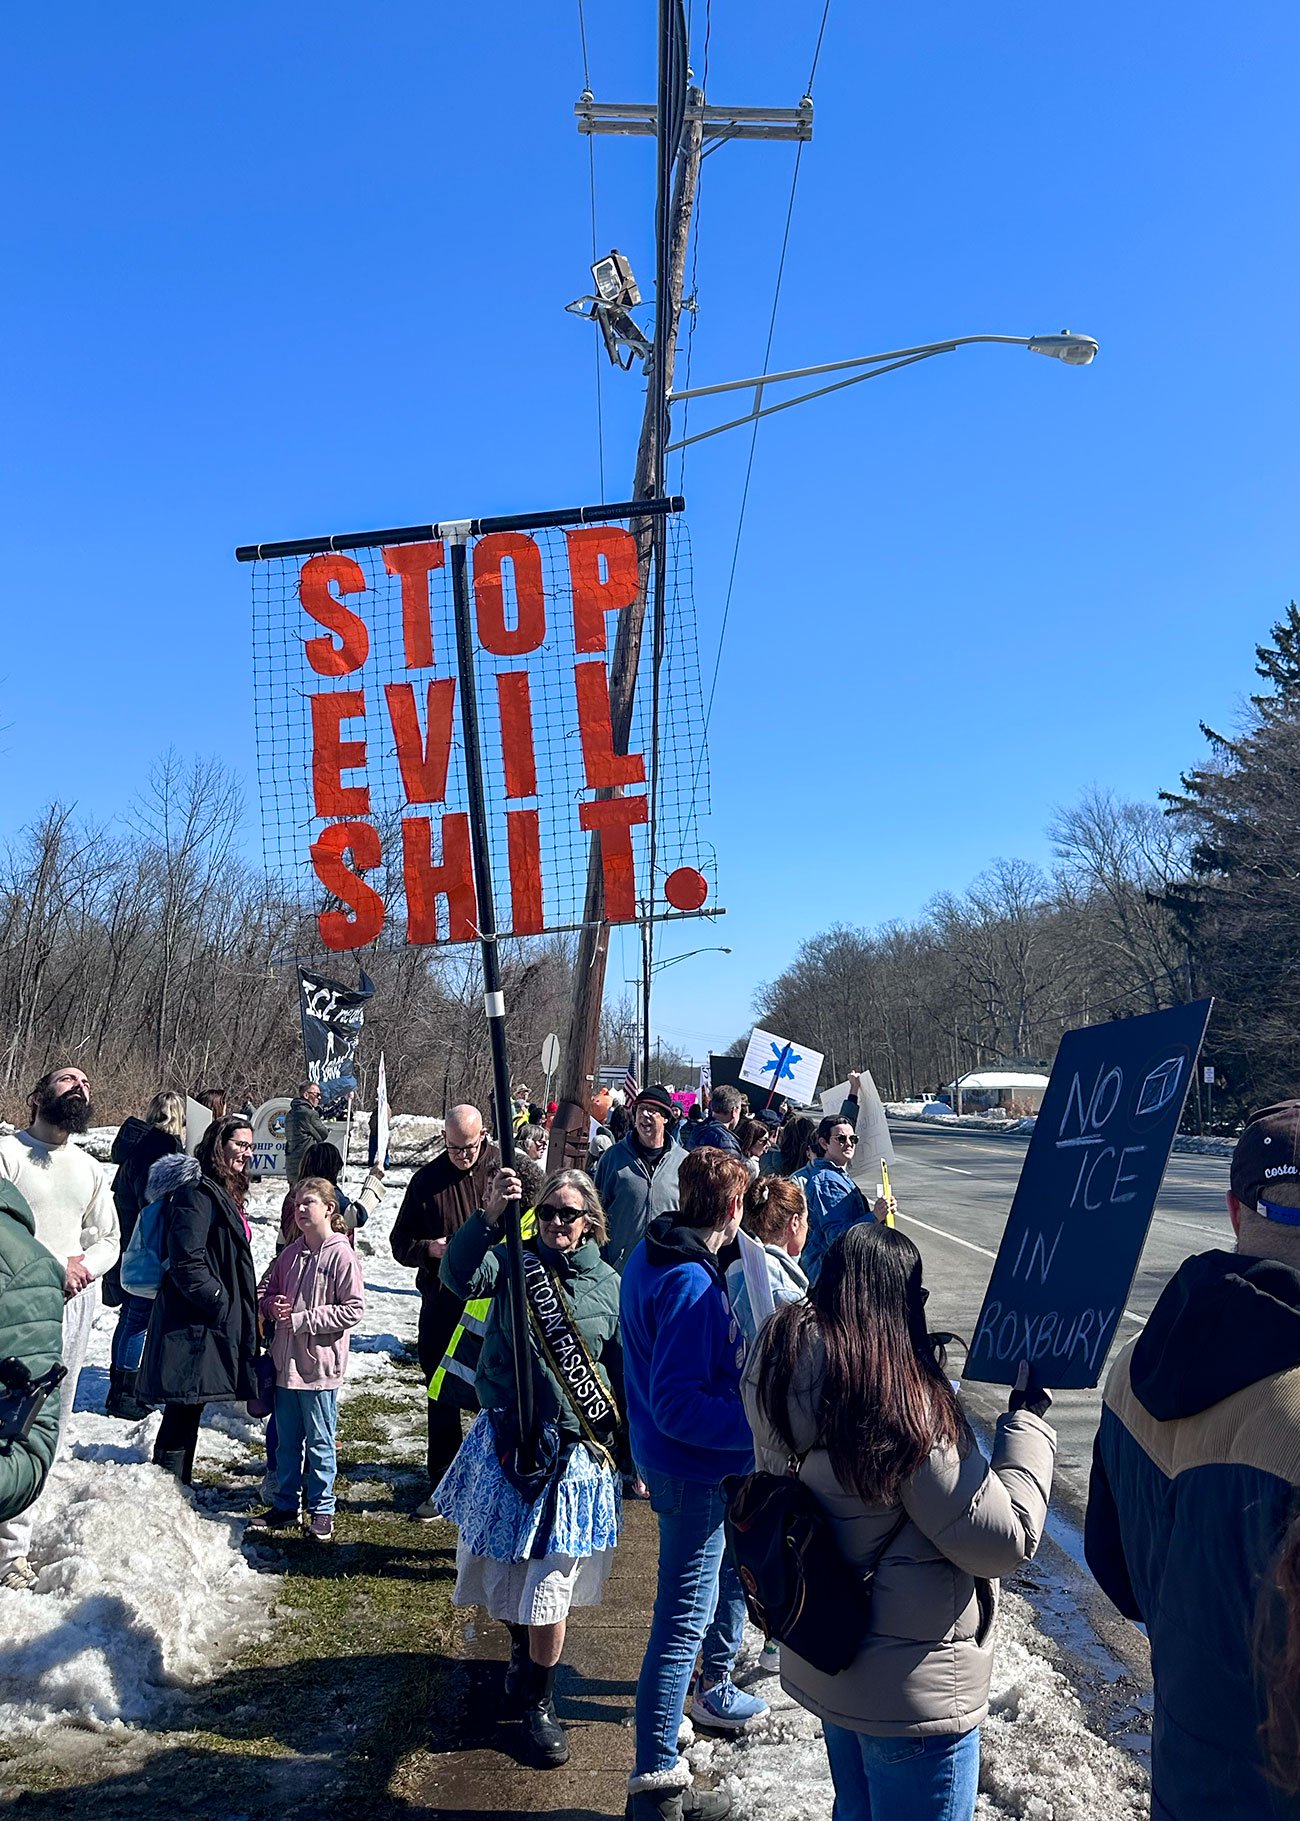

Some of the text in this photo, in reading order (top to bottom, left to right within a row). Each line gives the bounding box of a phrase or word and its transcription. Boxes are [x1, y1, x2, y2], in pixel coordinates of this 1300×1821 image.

[300, 526, 639, 676] STOP
[310, 661, 646, 817] EVIL
[309, 795, 708, 950] SHIT.
[1059, 1061, 1124, 1137] NO
[1069, 1146, 1148, 1210] ICE
[1265, 1164, 1298, 1179] costa
[1012, 1222, 1064, 1285] IN
[530, 1275, 566, 1338] TODAY,
[552, 1334, 609, 1423] FASCISTS!
[973, 1300, 1116, 1370] ROXBURY
